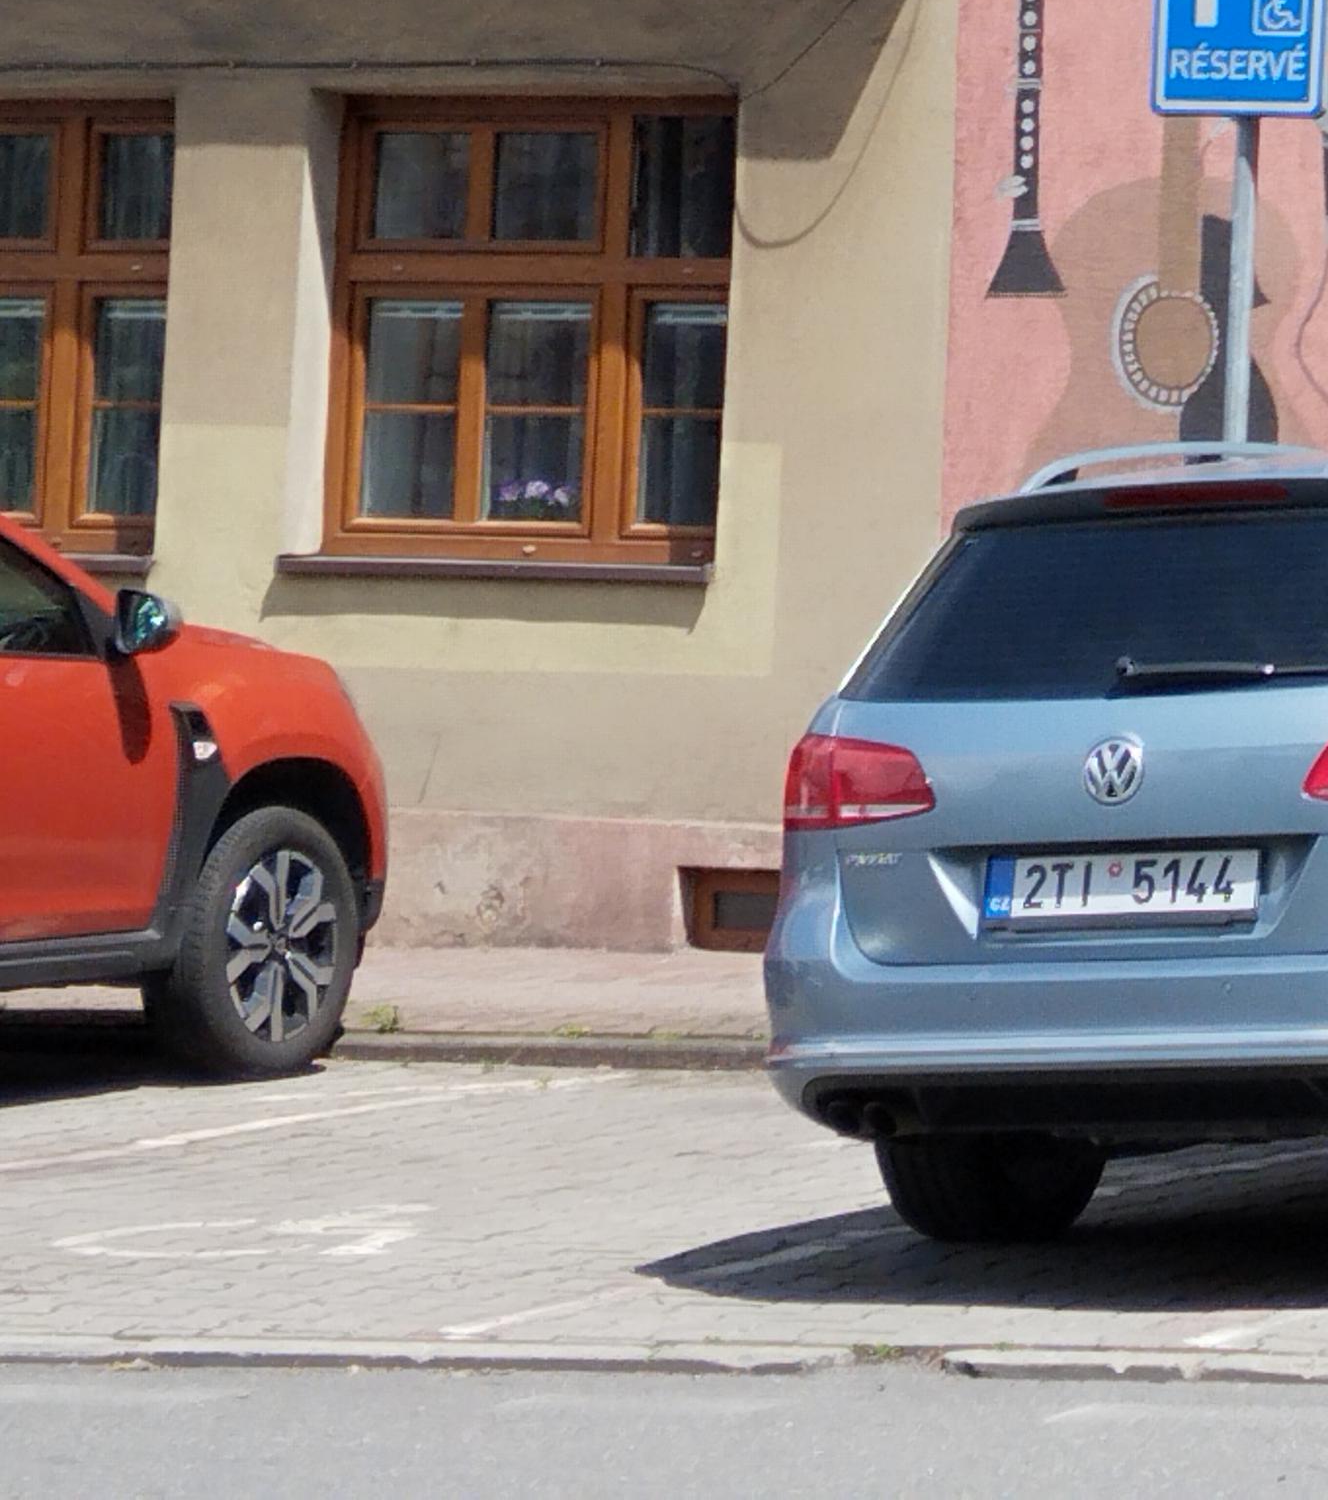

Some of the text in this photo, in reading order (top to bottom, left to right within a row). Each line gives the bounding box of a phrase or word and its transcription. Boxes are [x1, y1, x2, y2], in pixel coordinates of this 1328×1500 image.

[1169, 43, 1307, 81] RÉSERVÉ
[1023, 855, 1234, 908] 2TI 5144
